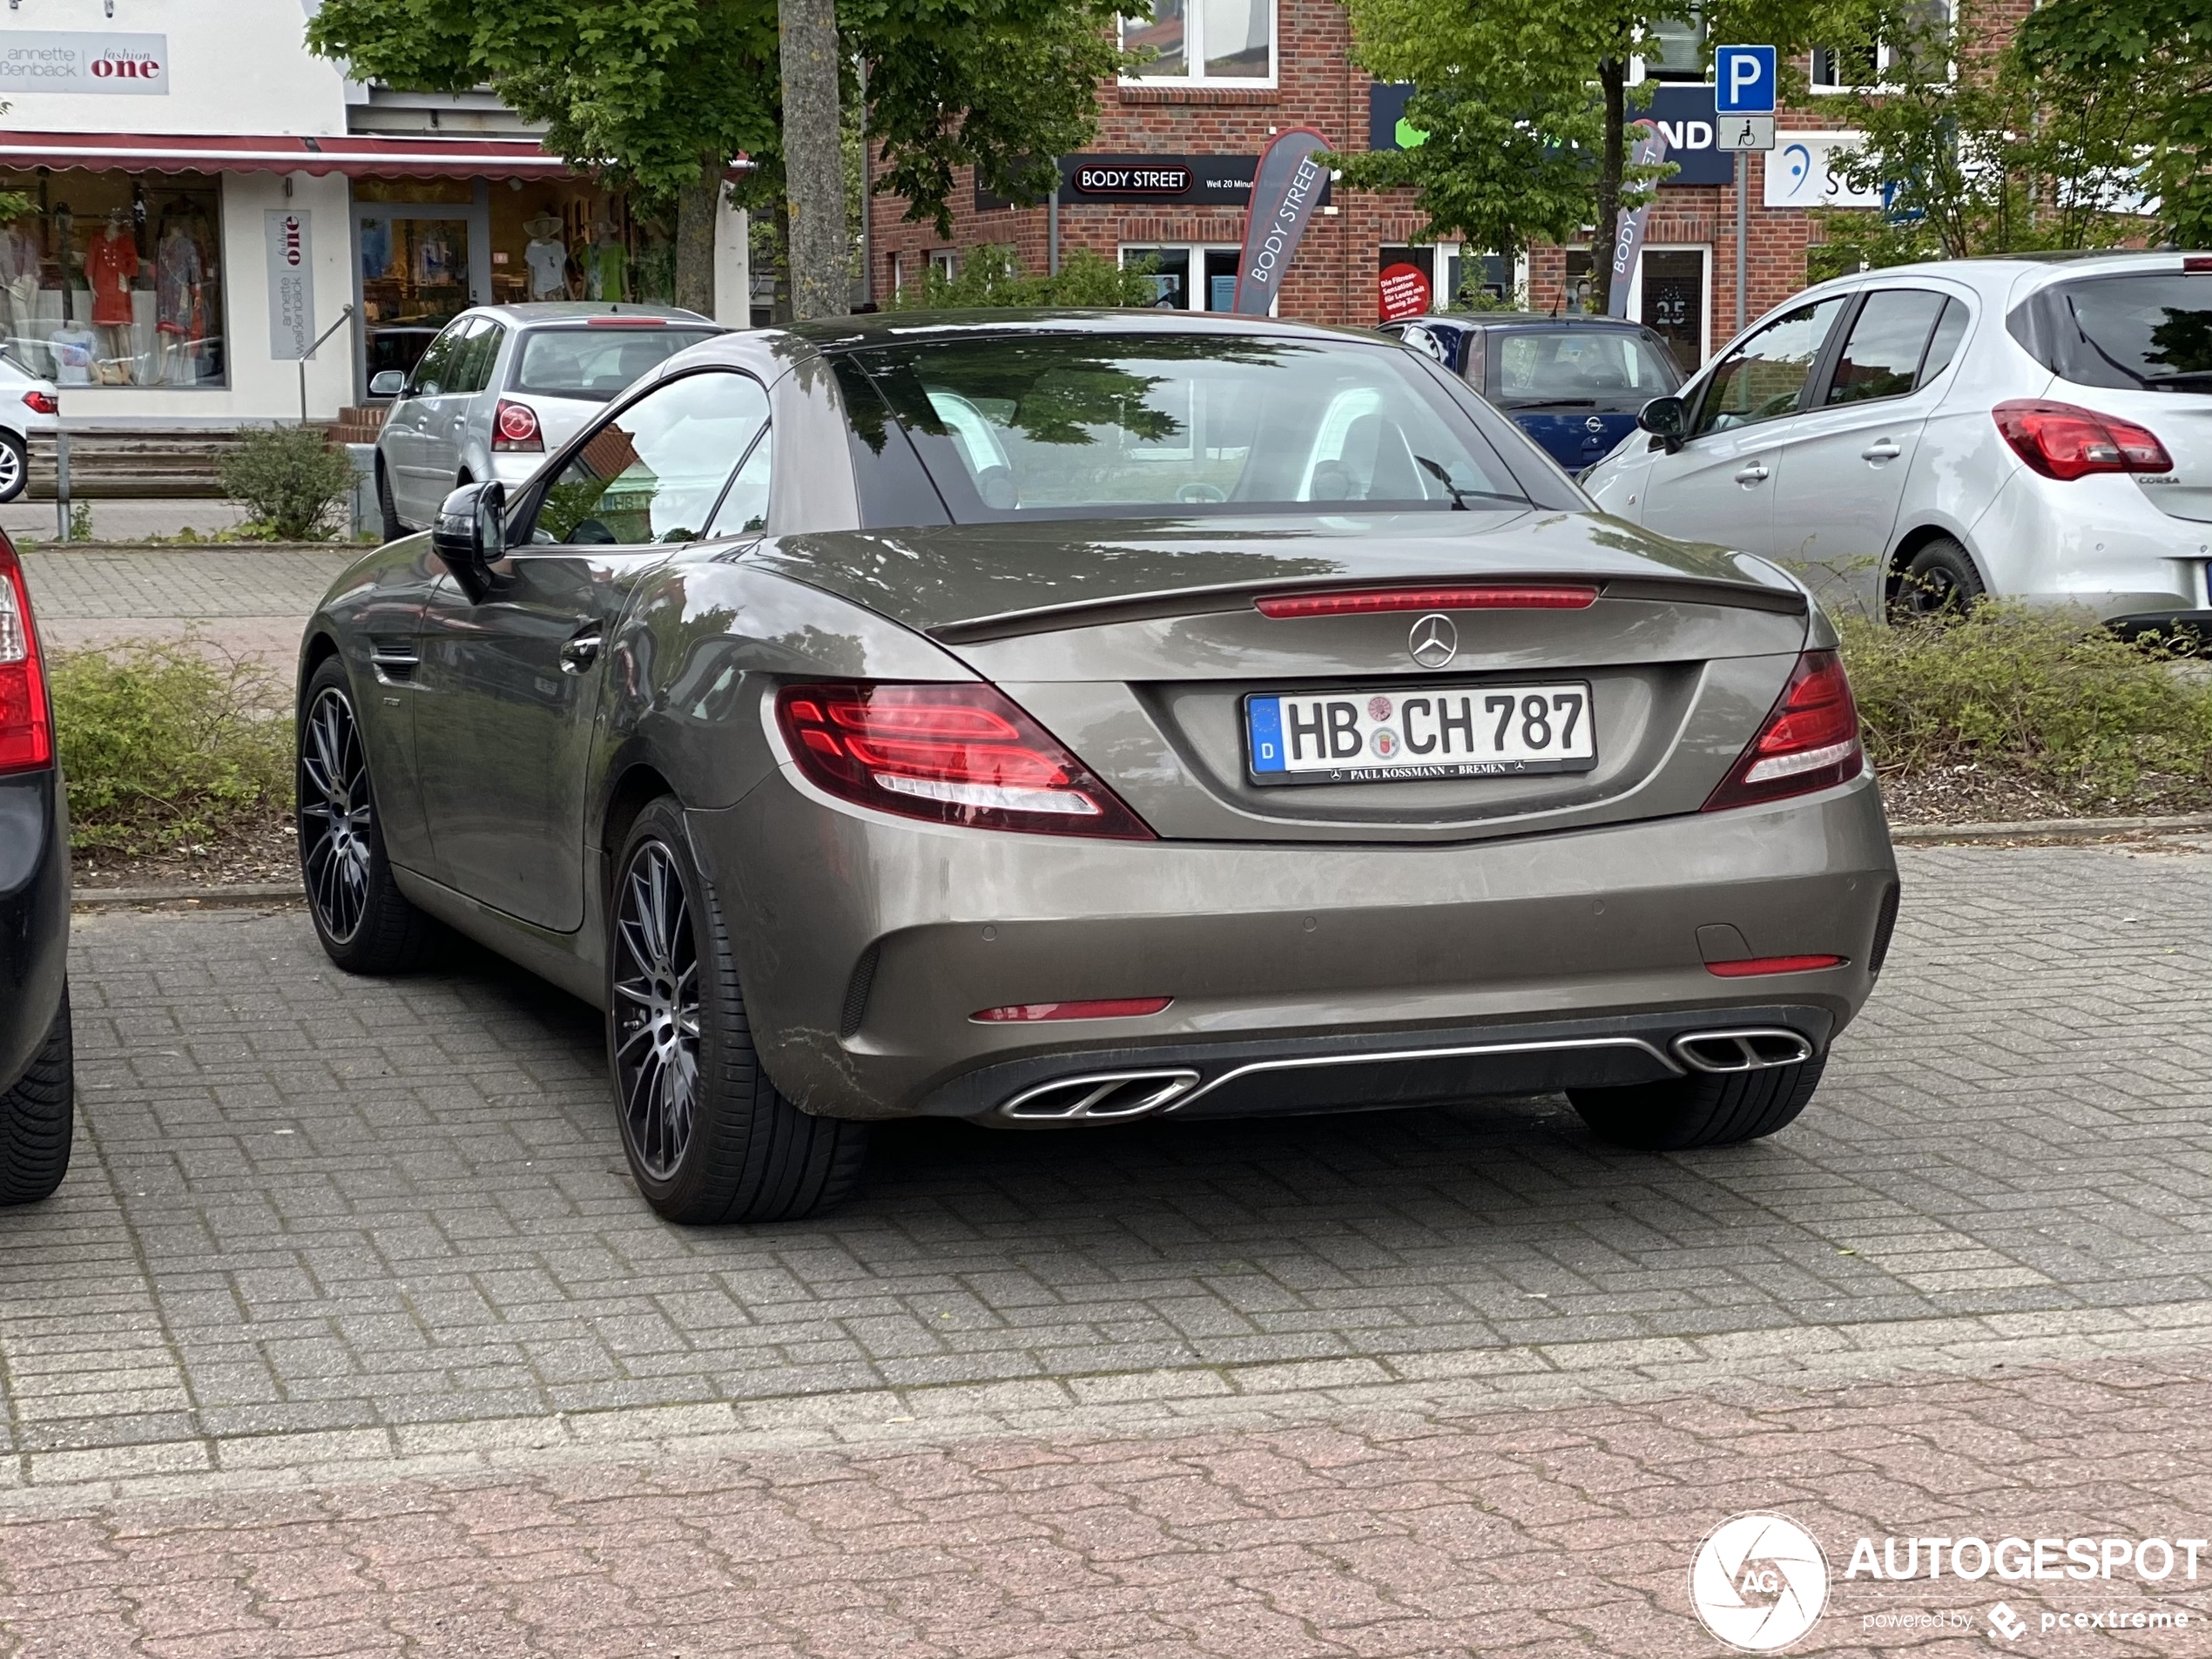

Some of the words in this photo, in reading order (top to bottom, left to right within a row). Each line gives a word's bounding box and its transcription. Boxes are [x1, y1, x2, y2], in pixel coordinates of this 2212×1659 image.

[8, 47, 75, 61] annette
[104, 47, 151, 60] fashion
[91, 59, 160, 78] one
[1730, 55, 1762, 104] P
[1082, 171, 1130, 186] BODY
[1133, 171, 1185, 187] STREET
[1206, 179, 1222, 188] Weil
[1223, 179, 1233, 188] 20
[1251, 222, 1288, 283] BODY
[1279, 156, 1318, 222] STREET
[278, 221, 287, 257] fashion
[286, 216, 301, 266] one
[1614, 214, 1637, 274] BODY
[280, 277, 292, 327] annette
[1413, 285, 1426, 294] mit
[291, 277, 304, 354] weißenbäck
[1288, 701, 1363, 759] HB
[1401, 698, 1474, 754] CH
[1485, 694, 1582, 751] 787
[1261, 743, 1273, 759] D
[1350, 770, 1380, 780] PAUL
[1382, 766, 1446, 779] KOSSMANN
[1458, 764, 1506, 775] BREMEN
